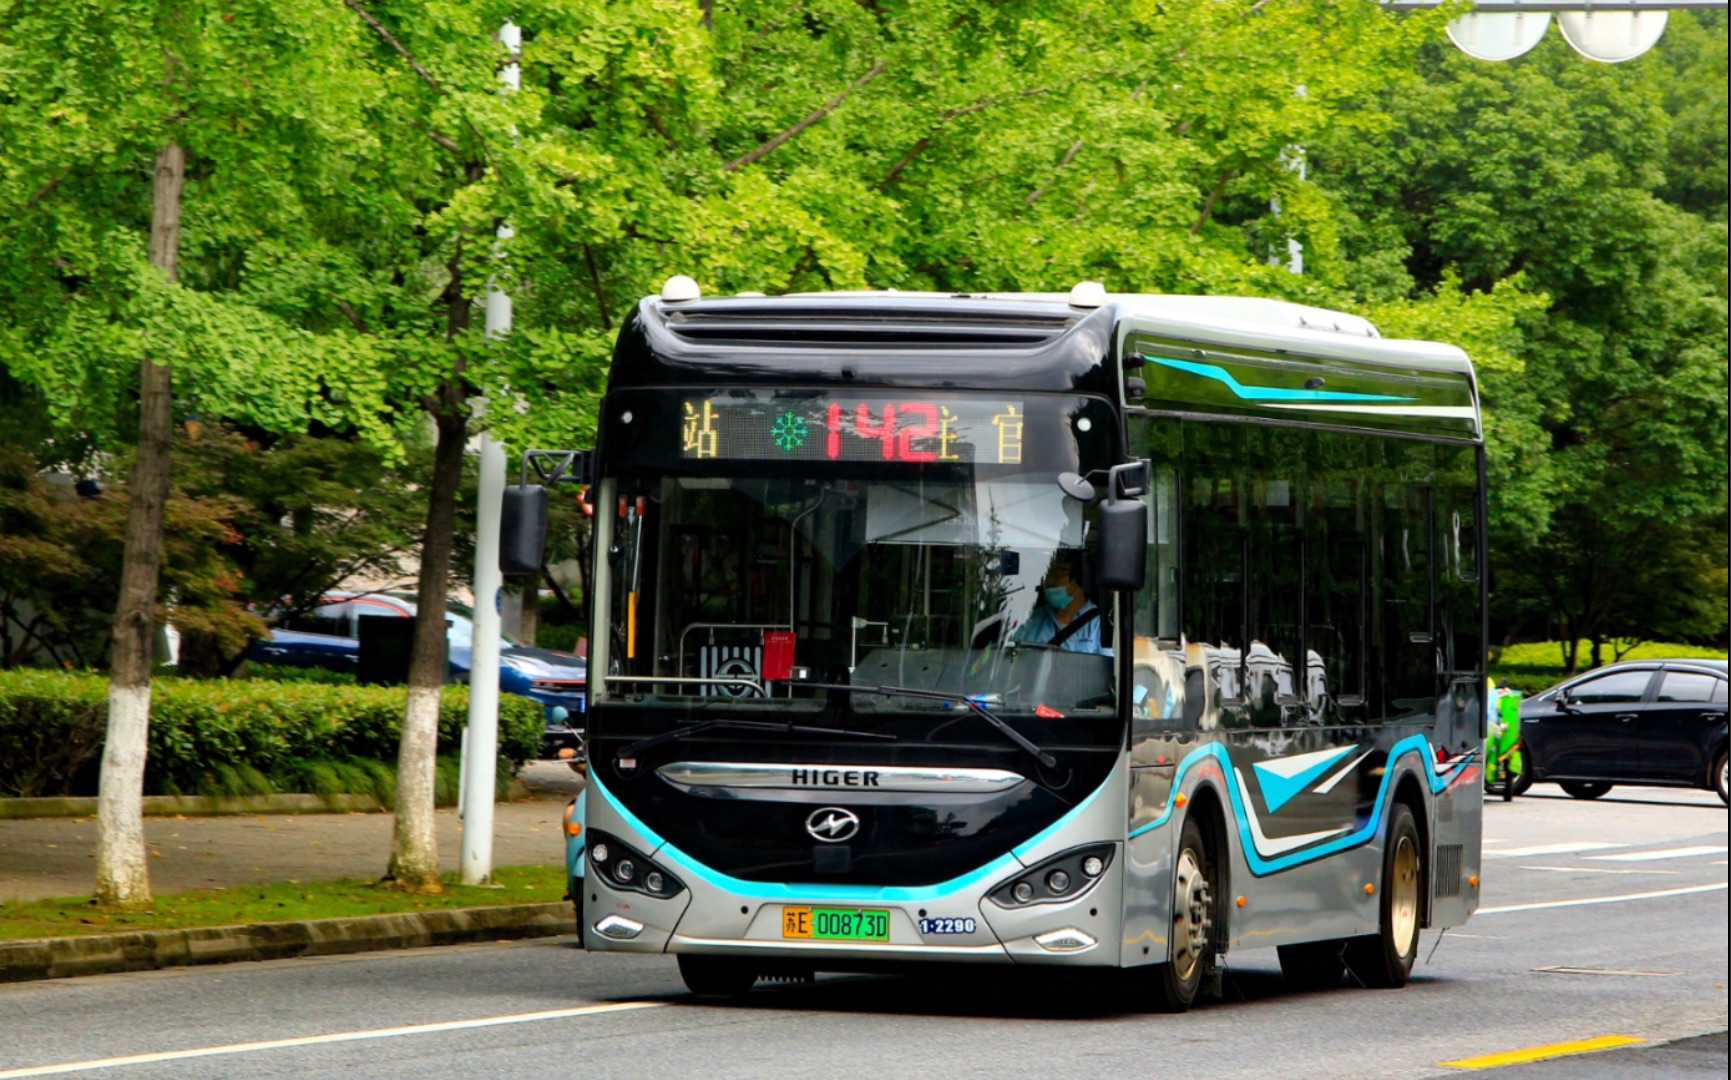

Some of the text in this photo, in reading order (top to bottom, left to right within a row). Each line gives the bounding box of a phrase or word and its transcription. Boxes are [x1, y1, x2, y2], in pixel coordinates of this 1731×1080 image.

[683, 400, 719, 459] 站
[826, 402, 938, 462] 142
[792, 769, 879, 786] HIGER
[818, 912, 887, 937] 00873D
